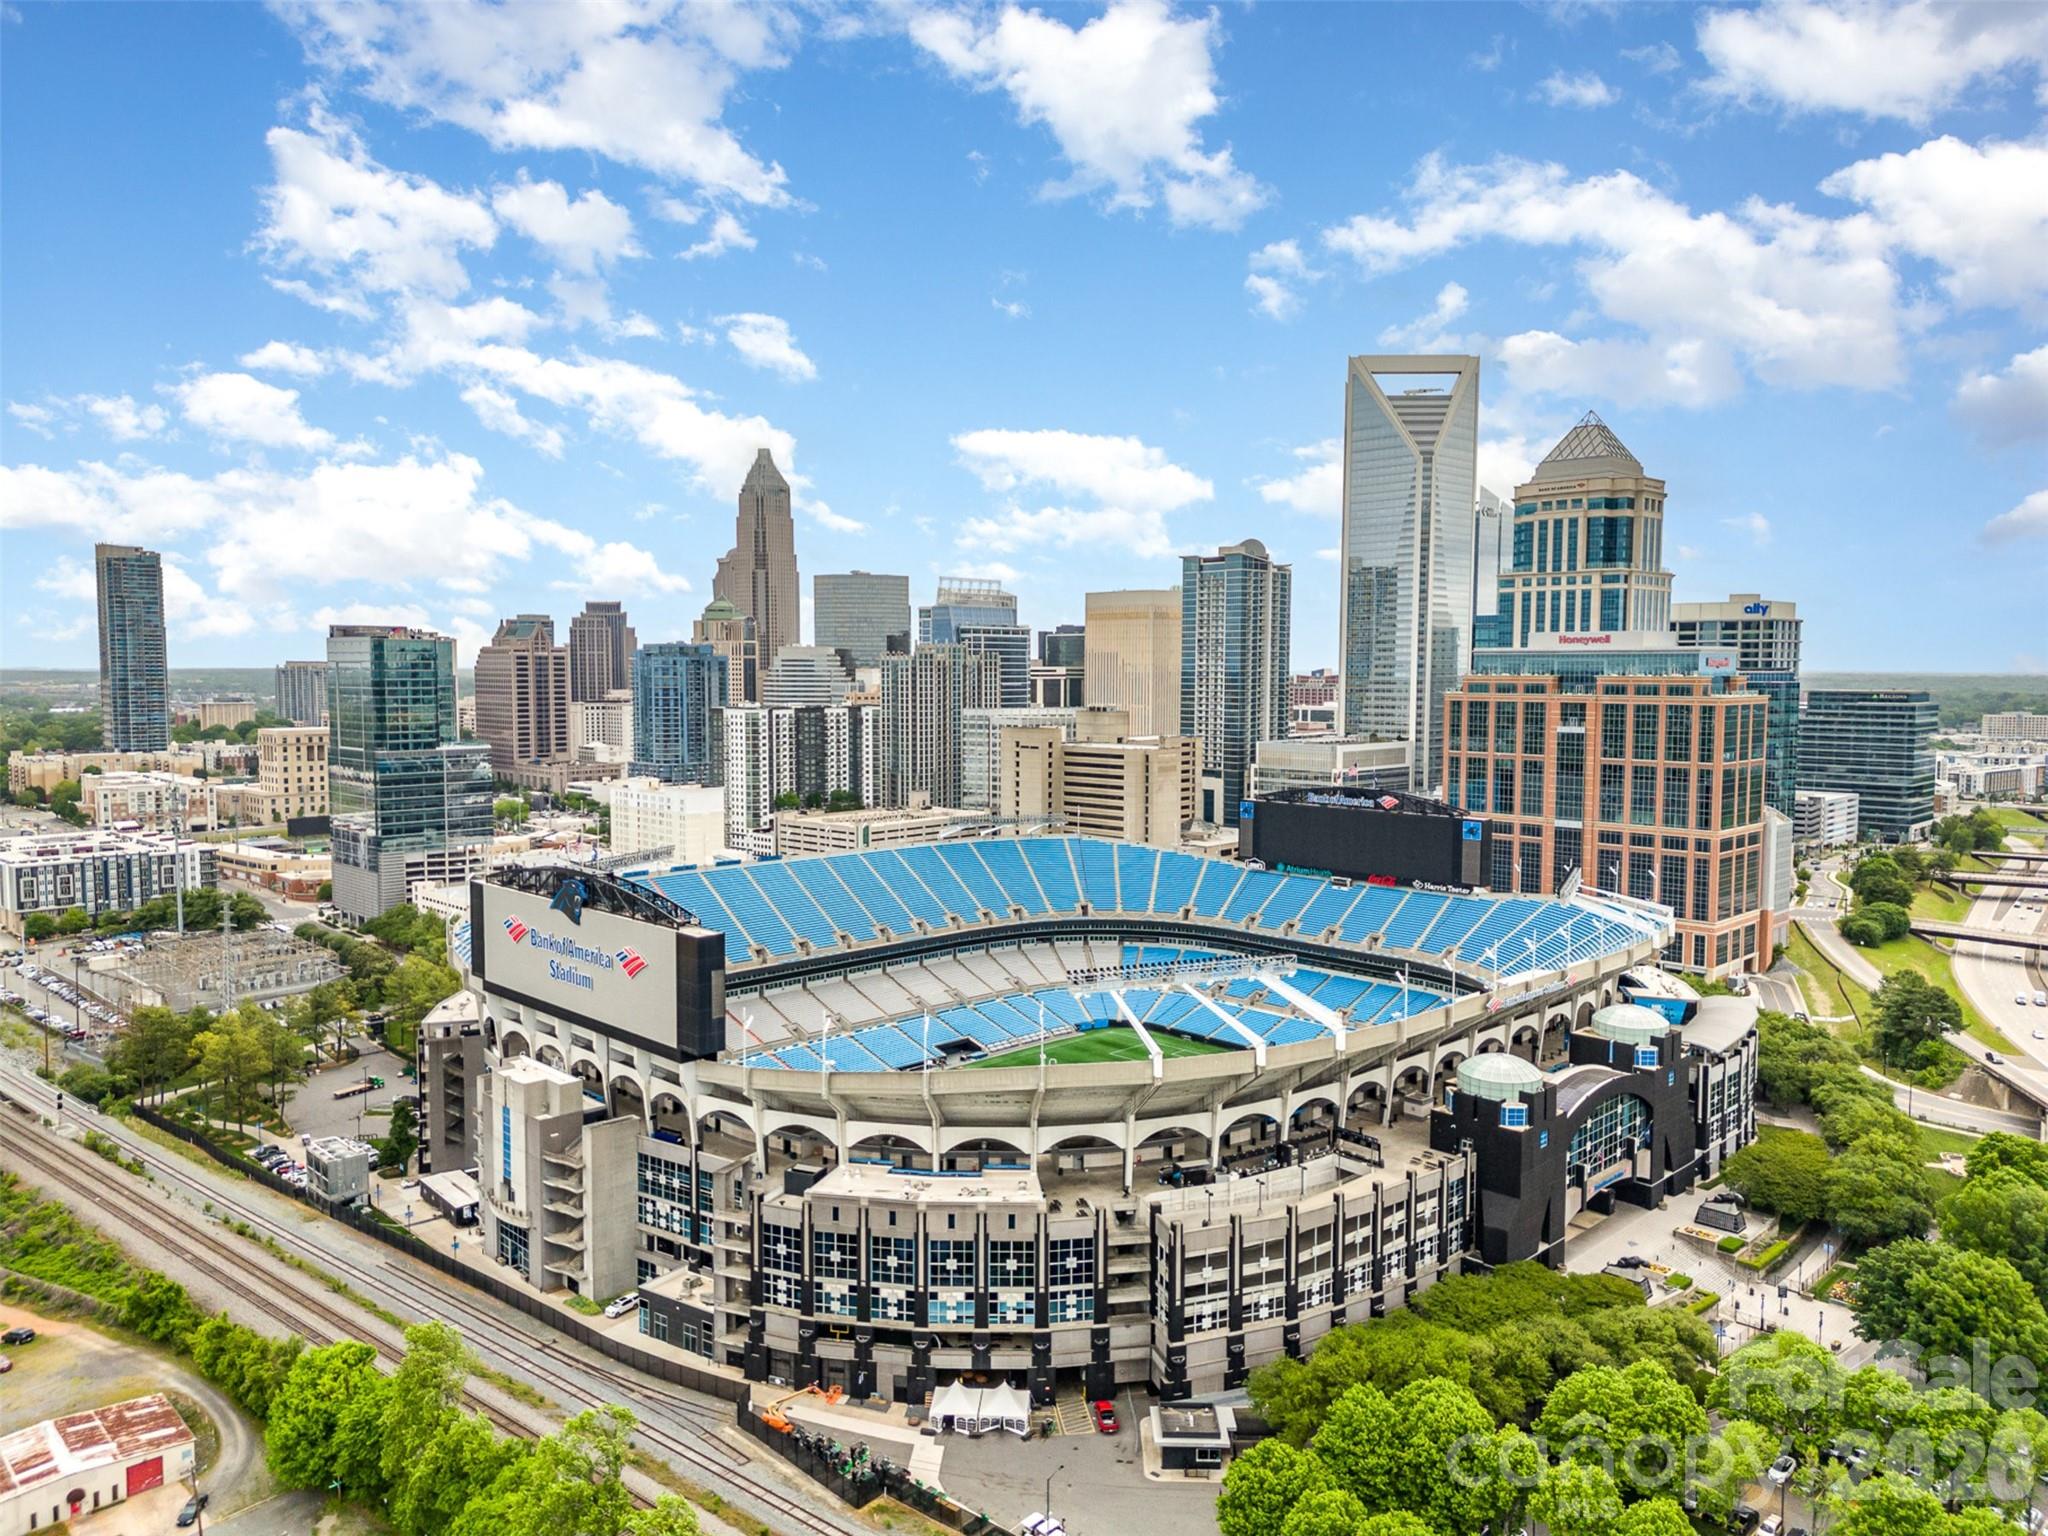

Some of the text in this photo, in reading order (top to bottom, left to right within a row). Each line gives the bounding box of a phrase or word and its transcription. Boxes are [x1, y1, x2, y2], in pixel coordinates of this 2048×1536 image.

[1744, 602, 1769, 617] ally
[1559, 635, 1611, 645] Honeywell
[530, 928, 556, 951] Bank
[565, 938, 615, 970] America
[549, 959, 594, 990] Stadium
